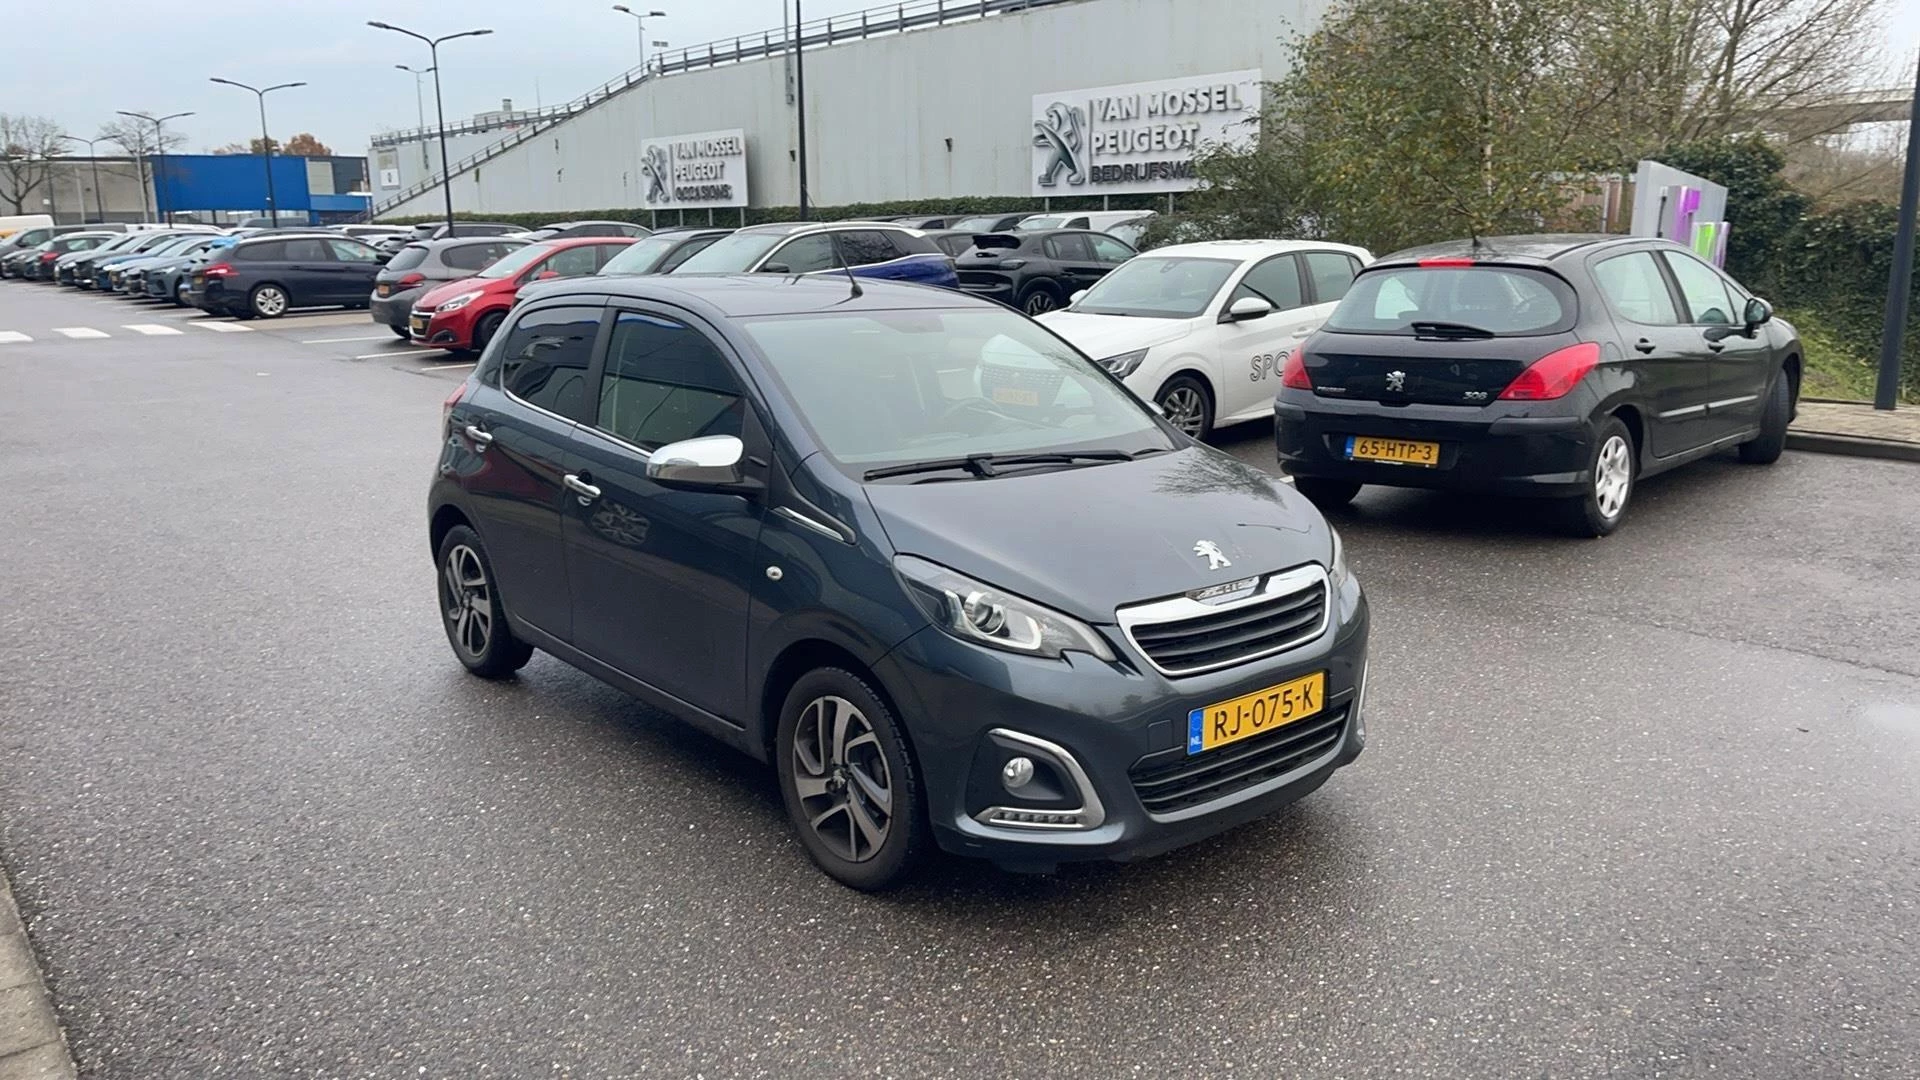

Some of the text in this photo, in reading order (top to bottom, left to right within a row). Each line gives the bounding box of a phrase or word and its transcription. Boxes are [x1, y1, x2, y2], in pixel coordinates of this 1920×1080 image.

[1092, 84, 1243, 121] VAN MOSSEL
[673, 135, 742, 160] VAN MOSSEL
[1092, 124, 1199, 156] PEUGEOT
[674, 161, 725, 181] PEUGEOT
[1249, 350, 1292, 382] SPO
[1359, 440, 1432, 461] 65-HTP-3
[1213, 681, 1314, 741] RJ-075-K
